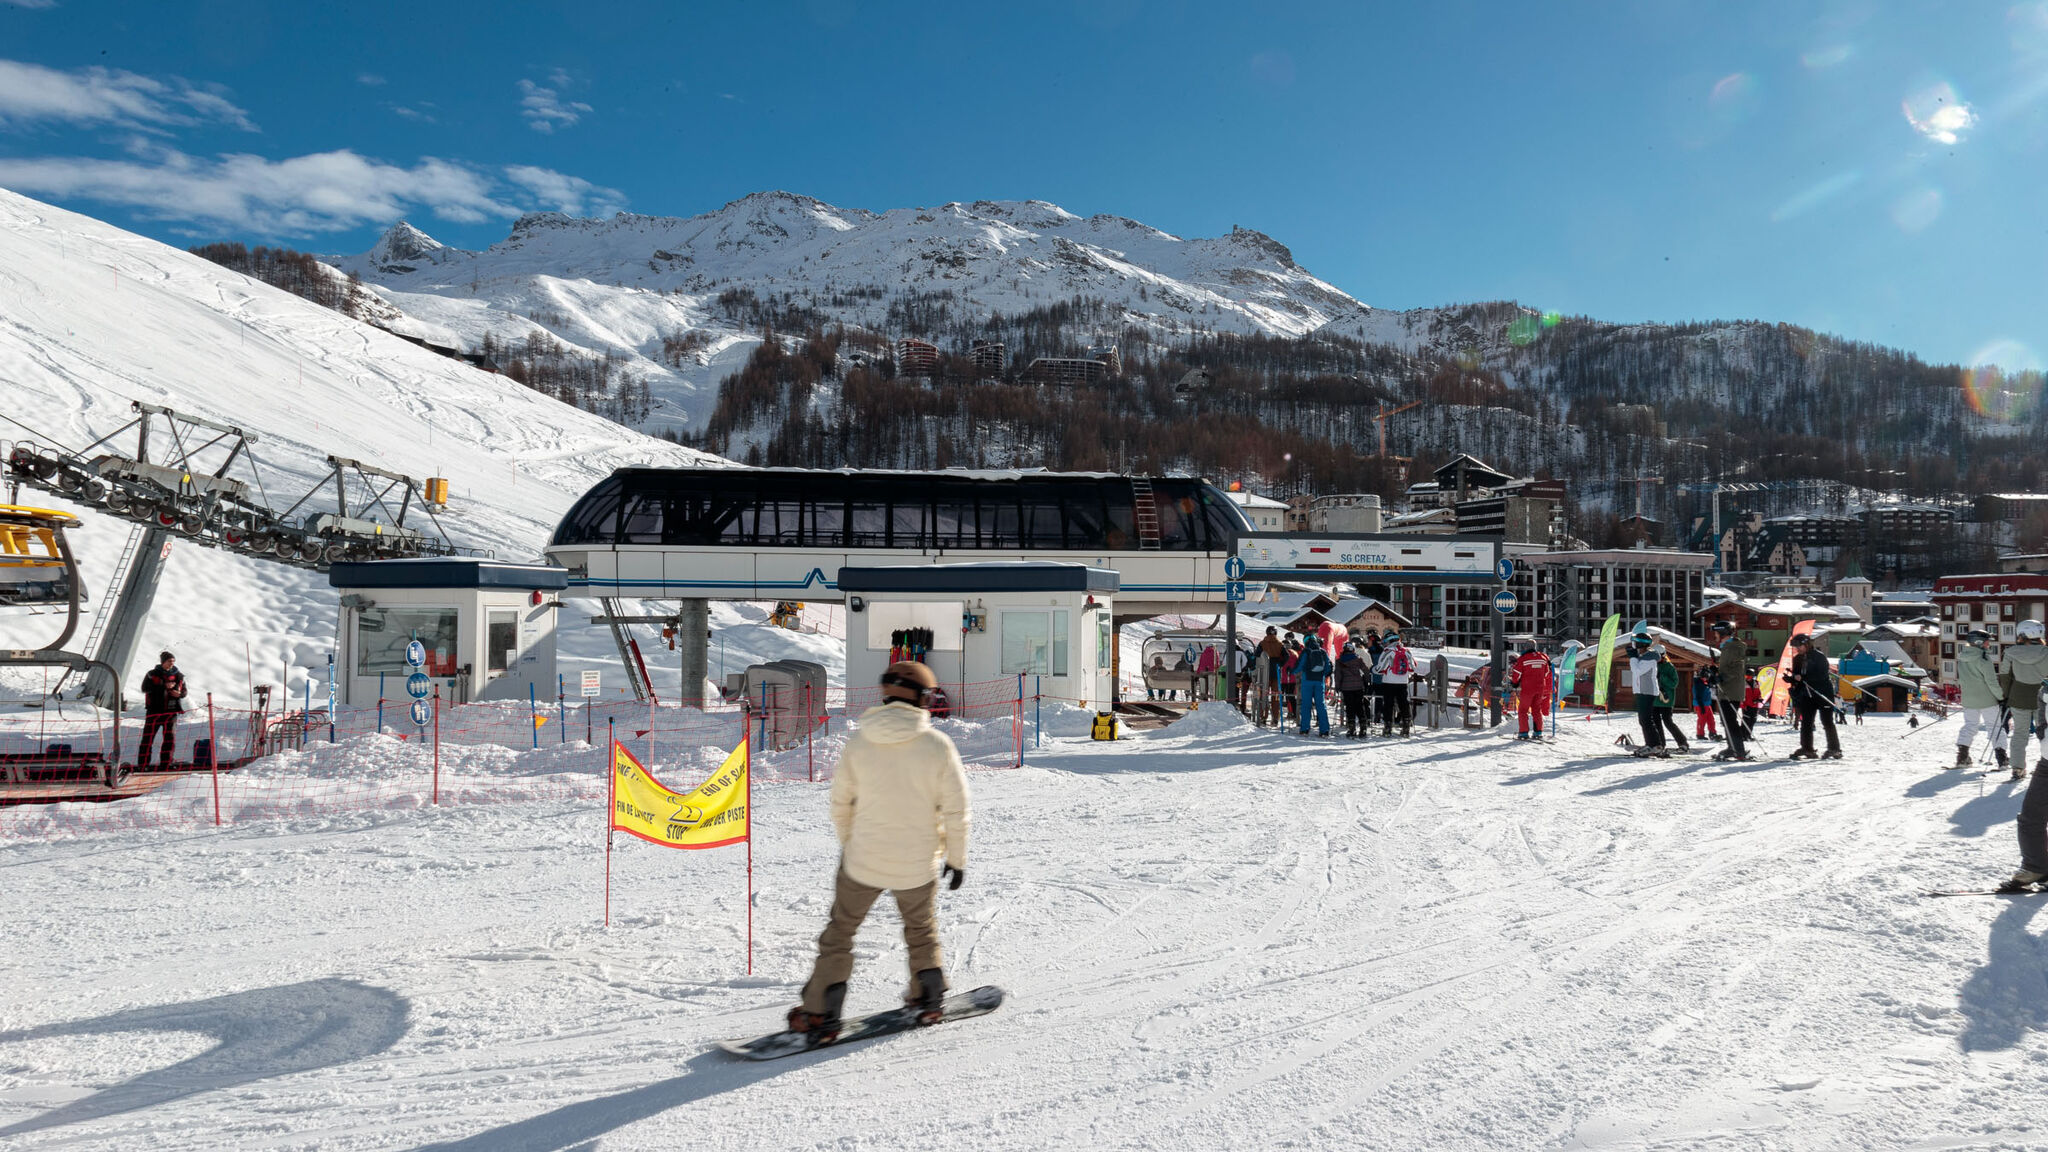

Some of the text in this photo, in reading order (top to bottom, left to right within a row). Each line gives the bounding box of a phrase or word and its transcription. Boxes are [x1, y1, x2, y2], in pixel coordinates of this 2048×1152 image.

[1340, 553, 1386, 564] SG CRETAZ
[701, 783, 721, 797] END
[718, 775, 732, 787] OF
[617, 800, 626, 813] FIN
[626, 803, 633, 816] DE
[713, 810, 726, 826] DER
[727, 806, 745, 822] PISTE
[666, 824, 690, 840] STOP
